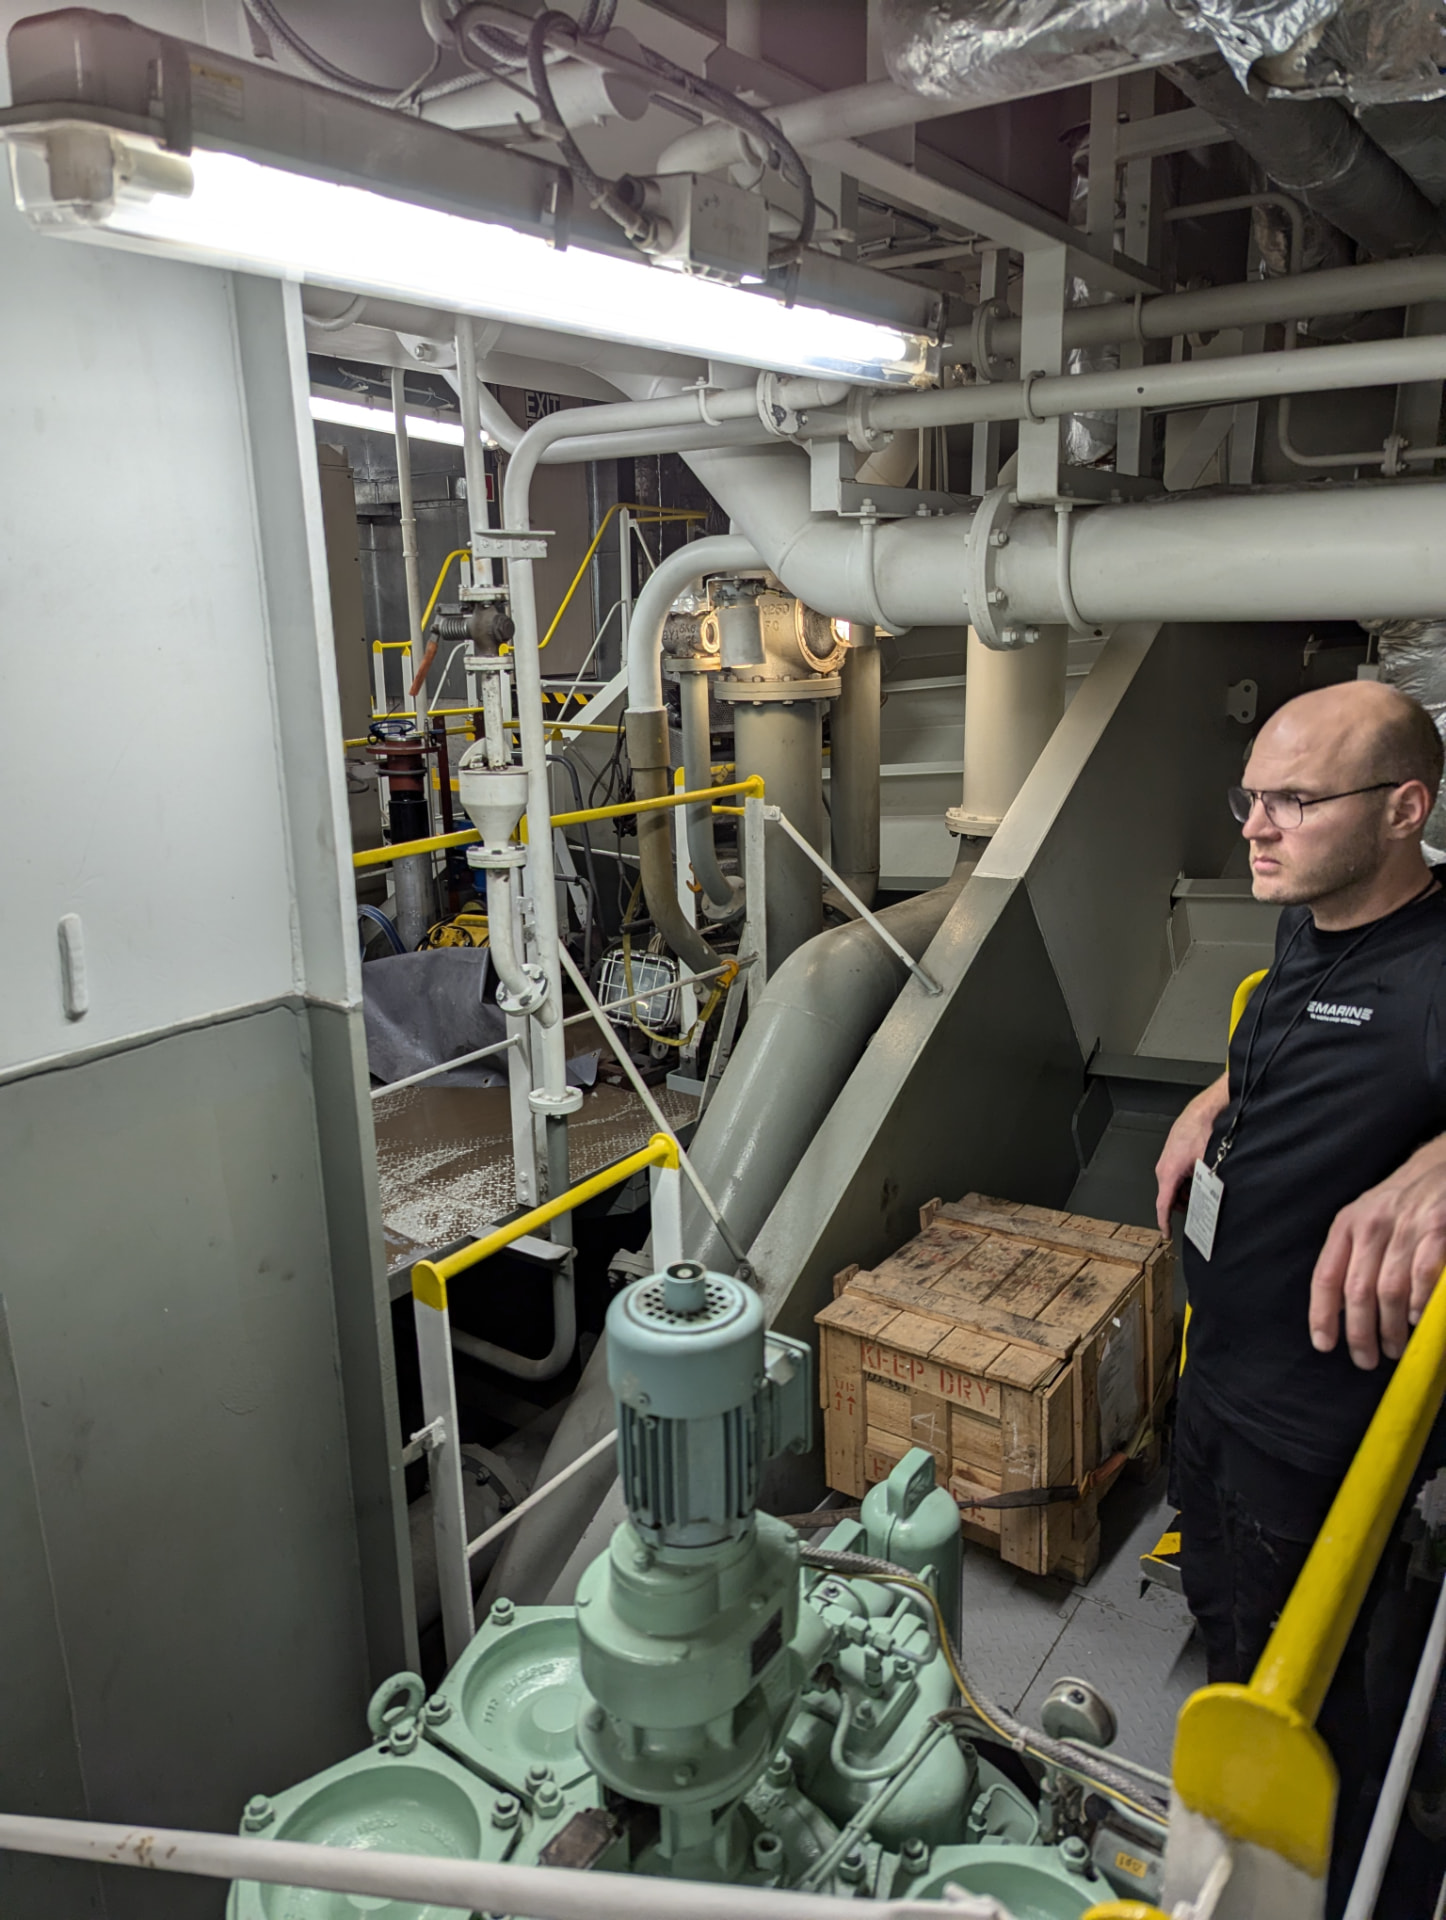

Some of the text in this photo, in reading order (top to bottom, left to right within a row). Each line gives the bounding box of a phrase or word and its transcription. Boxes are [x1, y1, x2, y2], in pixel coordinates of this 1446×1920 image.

[525, 391, 560, 418] EXIT
[860, 1342, 993, 1407] KEEP DRY
